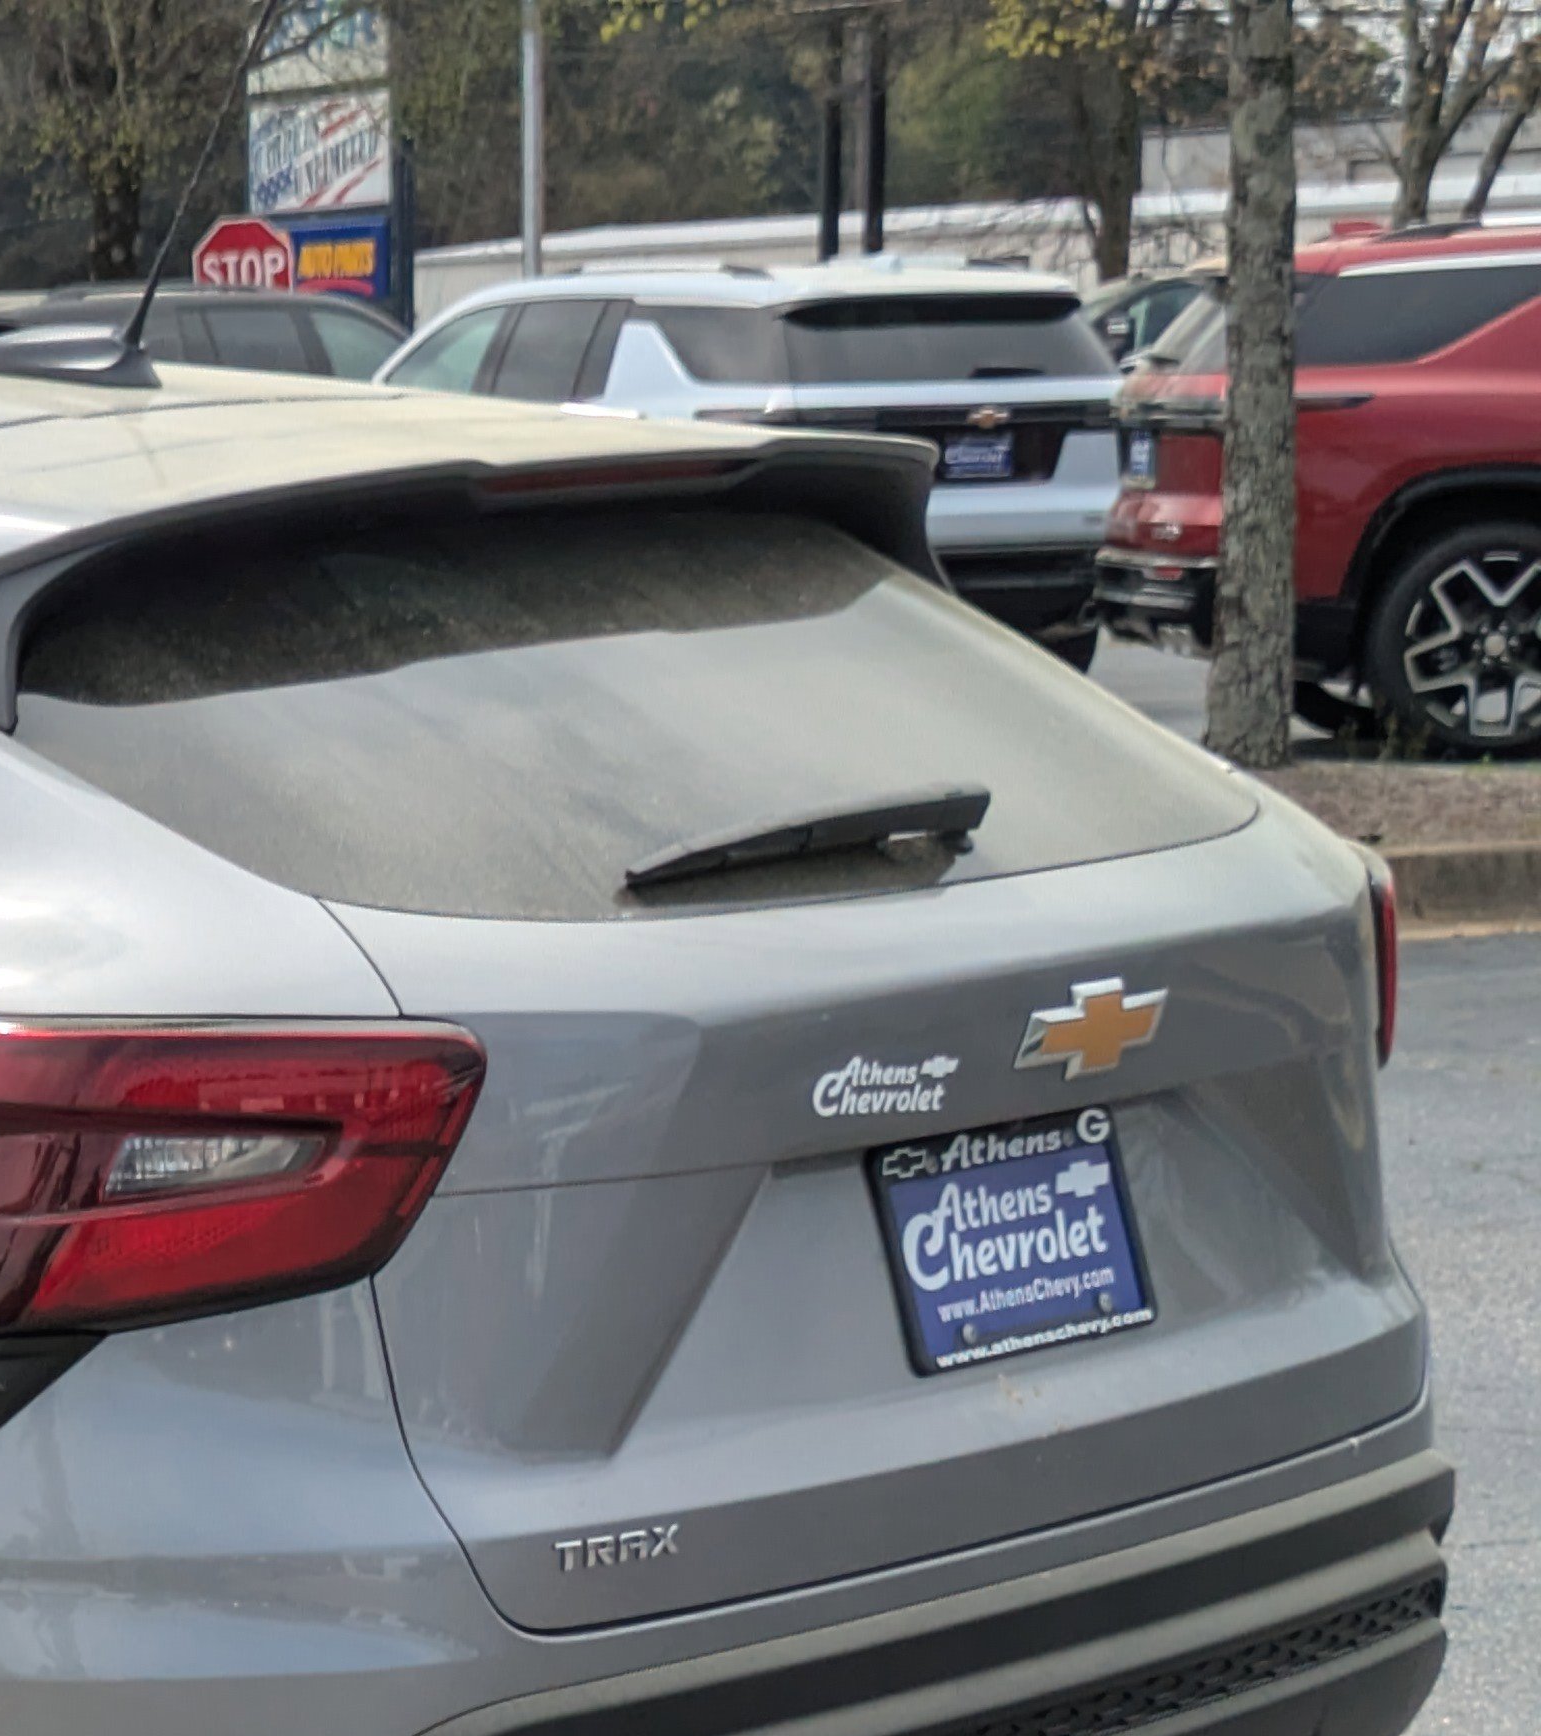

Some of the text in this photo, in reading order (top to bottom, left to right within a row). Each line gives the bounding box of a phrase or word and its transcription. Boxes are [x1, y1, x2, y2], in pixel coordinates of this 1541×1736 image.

[202, 246, 286, 288] STOP
[812, 1070, 946, 1117] Chevrolet
[828, 1056, 919, 1092] Athens
[941, 1108, 1111, 1172] Athens G
[926, 1182, 1053, 1244] Athens
[902, 1204, 1108, 1292] Chevrolet
[553, 1522, 680, 1573] TRAX
